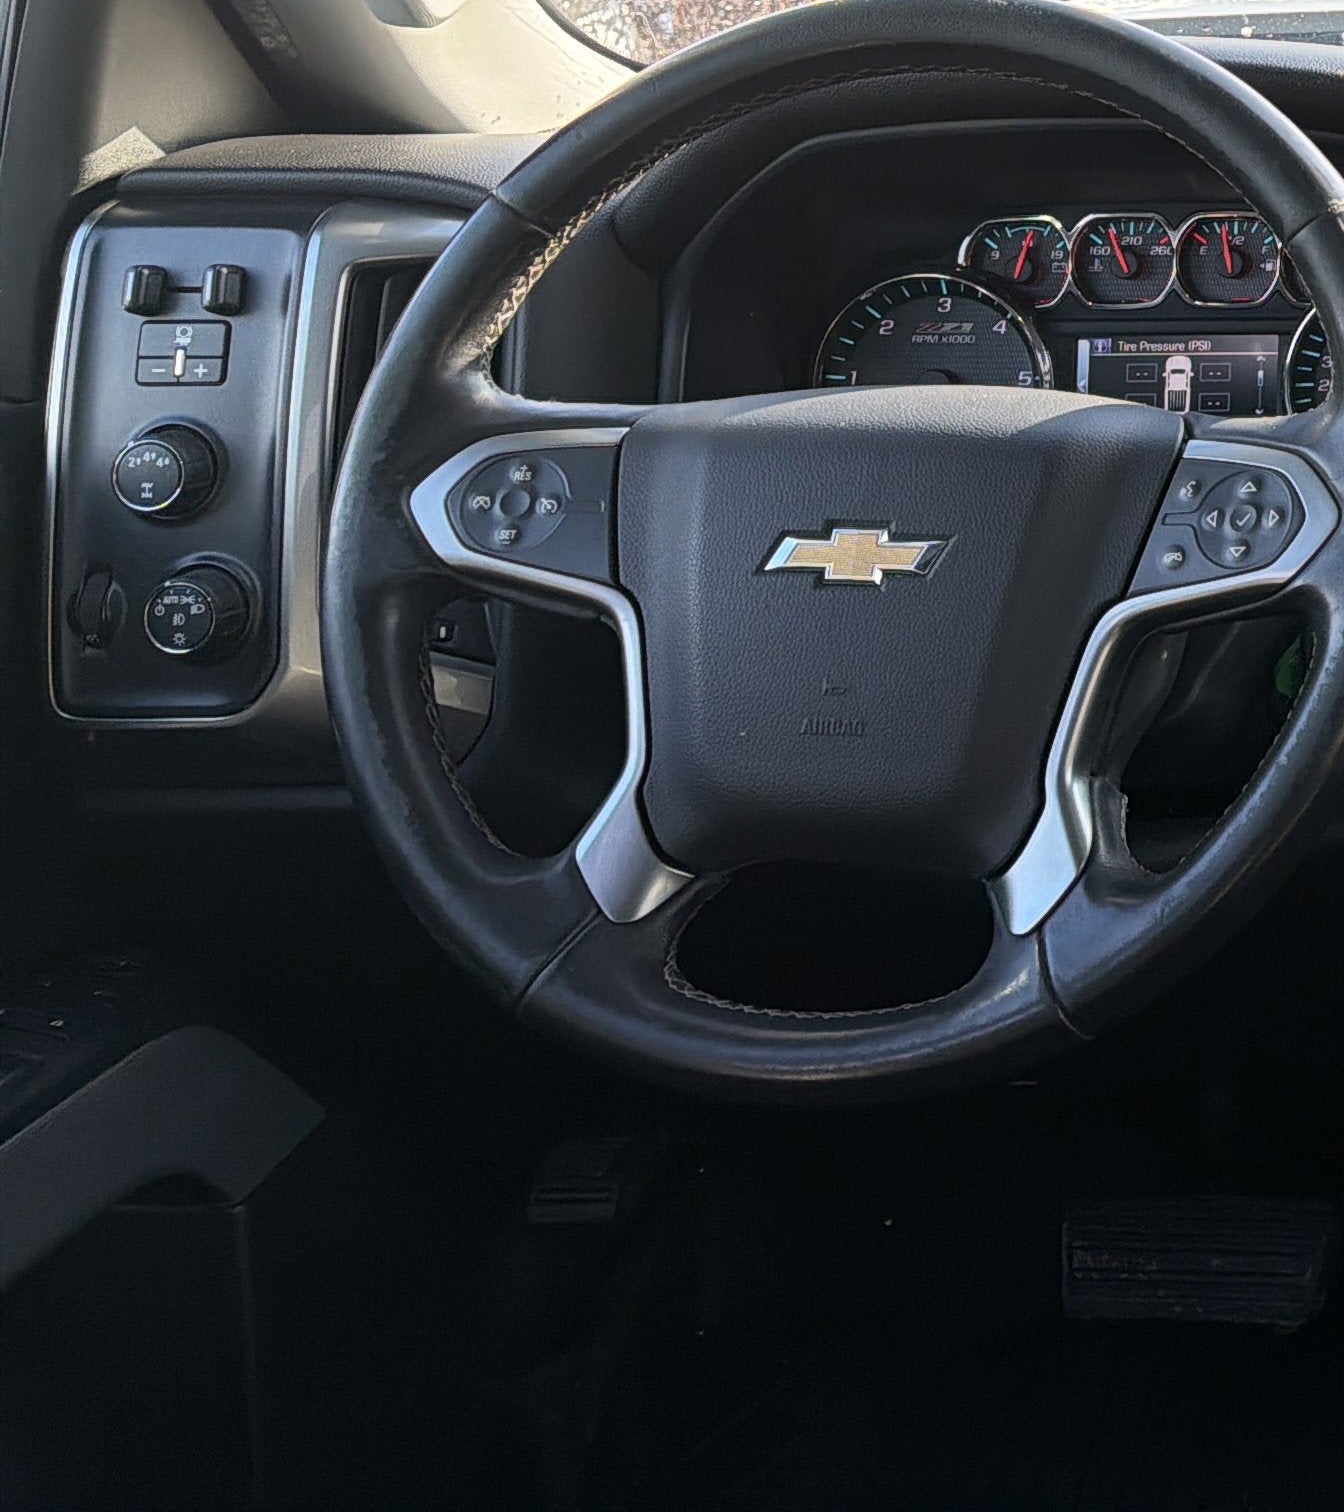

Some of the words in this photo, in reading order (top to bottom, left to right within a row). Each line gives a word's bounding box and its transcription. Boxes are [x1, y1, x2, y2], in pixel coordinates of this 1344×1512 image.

[1089, 245, 1111, 256] 160
[1121, 236, 1143, 246] 210
[937, 298, 952, 313] 3
[879, 320, 895, 335] 2
[992, 320, 1007, 335] 4
[911, 335, 938, 344] RPM
[1118, 340, 1137, 352] Tire
[1140, 340, 1186, 352] Pressure
[1188, 340, 1211, 352] (PSI)
[1018, 371, 1032, 386] 5
[514, 471, 532, 481] RES
[498, 529, 517, 539] SET
[801, 719, 865, 736] AIRBAG
